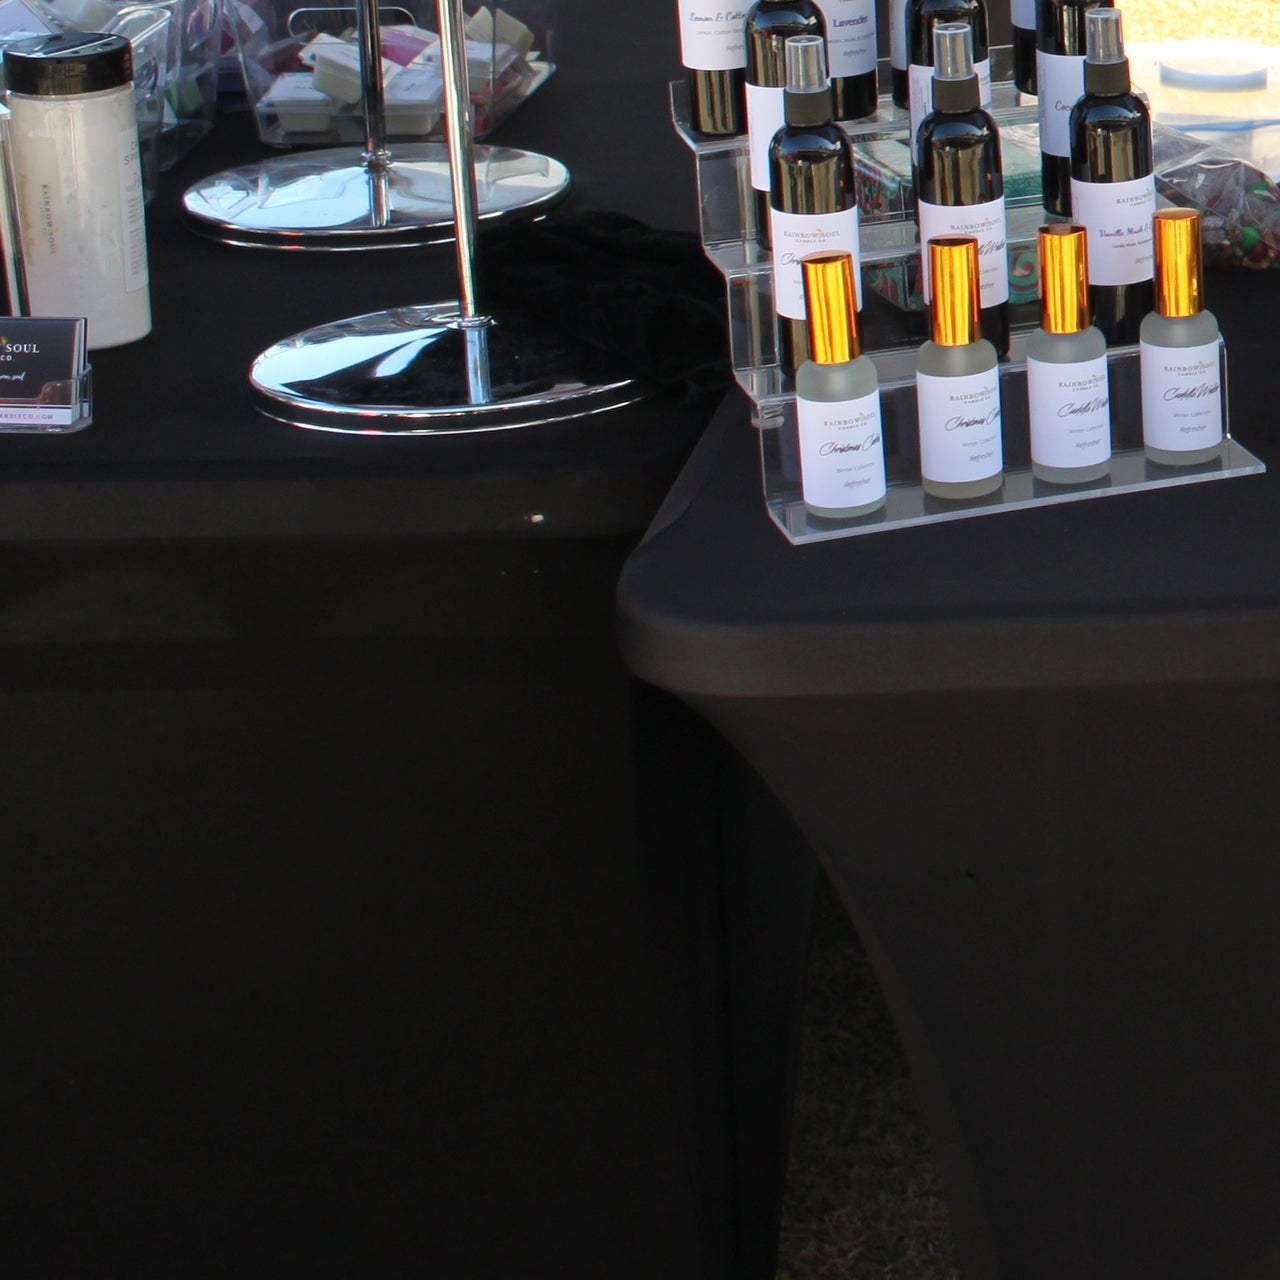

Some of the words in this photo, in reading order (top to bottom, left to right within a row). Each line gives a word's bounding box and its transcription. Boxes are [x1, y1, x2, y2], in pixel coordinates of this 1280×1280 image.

[689, 12, 713, 22] Lemon
[715, 11, 723, 22] &
[725, 10, 748, 22] Cotto
[832, 14, 869, 29] Lavender
[41, 184, 53, 228] RAINBOW
[47, 230, 57, 255] SOUL
[950, 223, 985, 231] RAINBOW
[783, 230, 819, 239] RAINBOW
[5, 343, 40, 354] SOUL
[1163, 363, 1199, 372] RAINBOW
[1058, 378, 1094, 388] RAINBOW
[949, 391, 984, 402] RAINBOW
[823, 415, 861, 427] RAINBOW
[819, 440, 862, 457] Christmas
